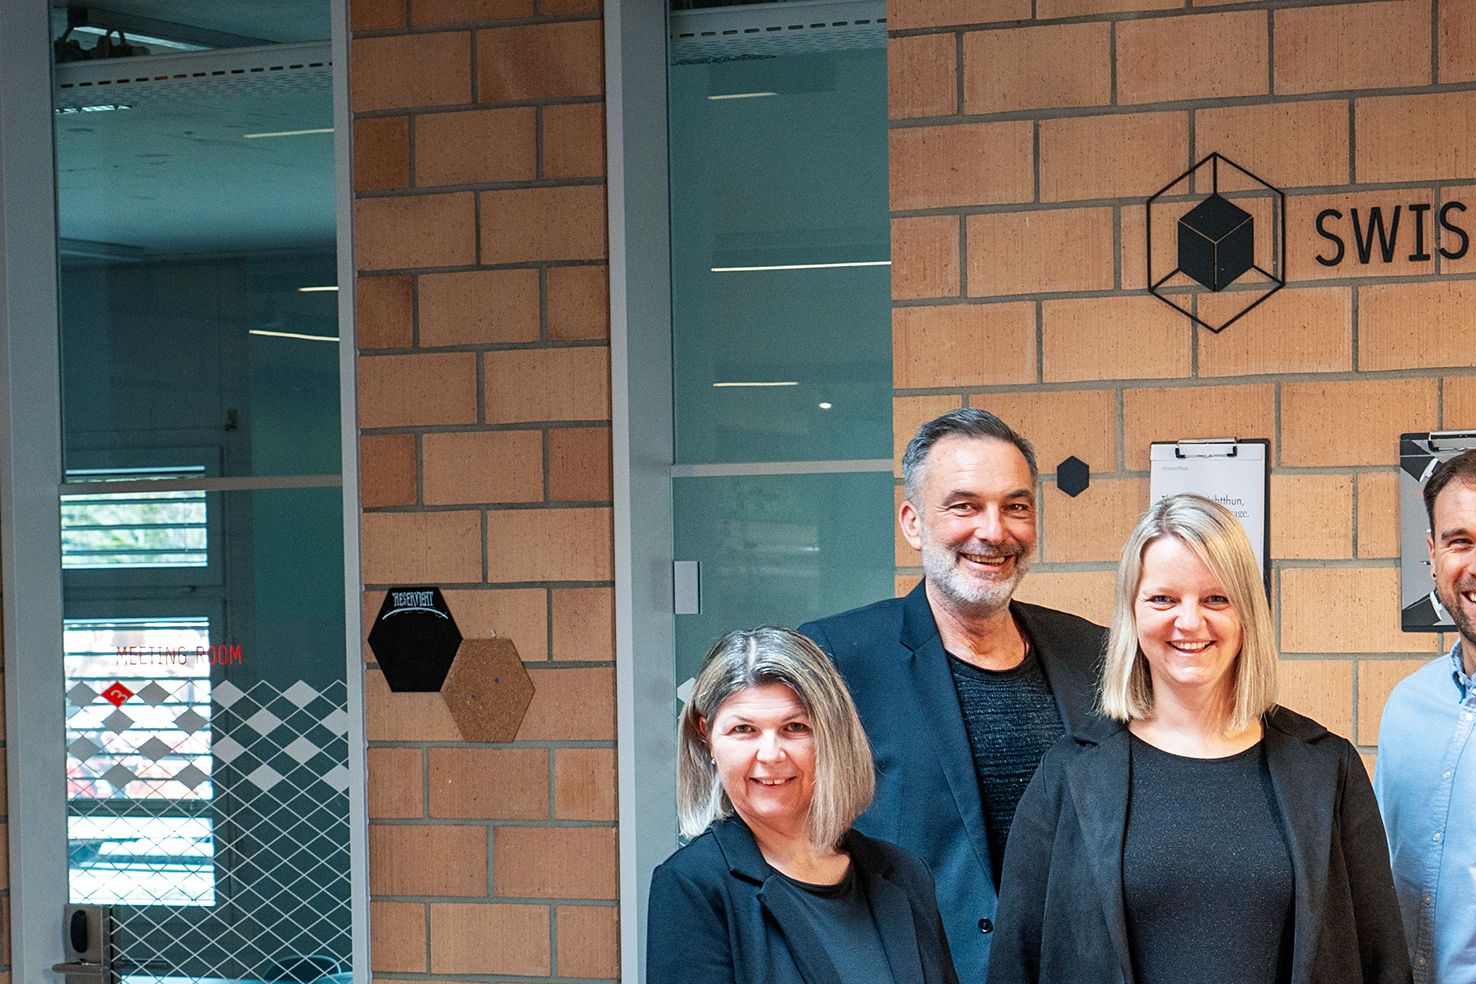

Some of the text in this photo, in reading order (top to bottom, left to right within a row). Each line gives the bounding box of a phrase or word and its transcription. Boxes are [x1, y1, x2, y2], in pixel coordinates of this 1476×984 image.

[116, 645, 243, 666] MEETING ROOM
[110, 689, 129, 704] 3
